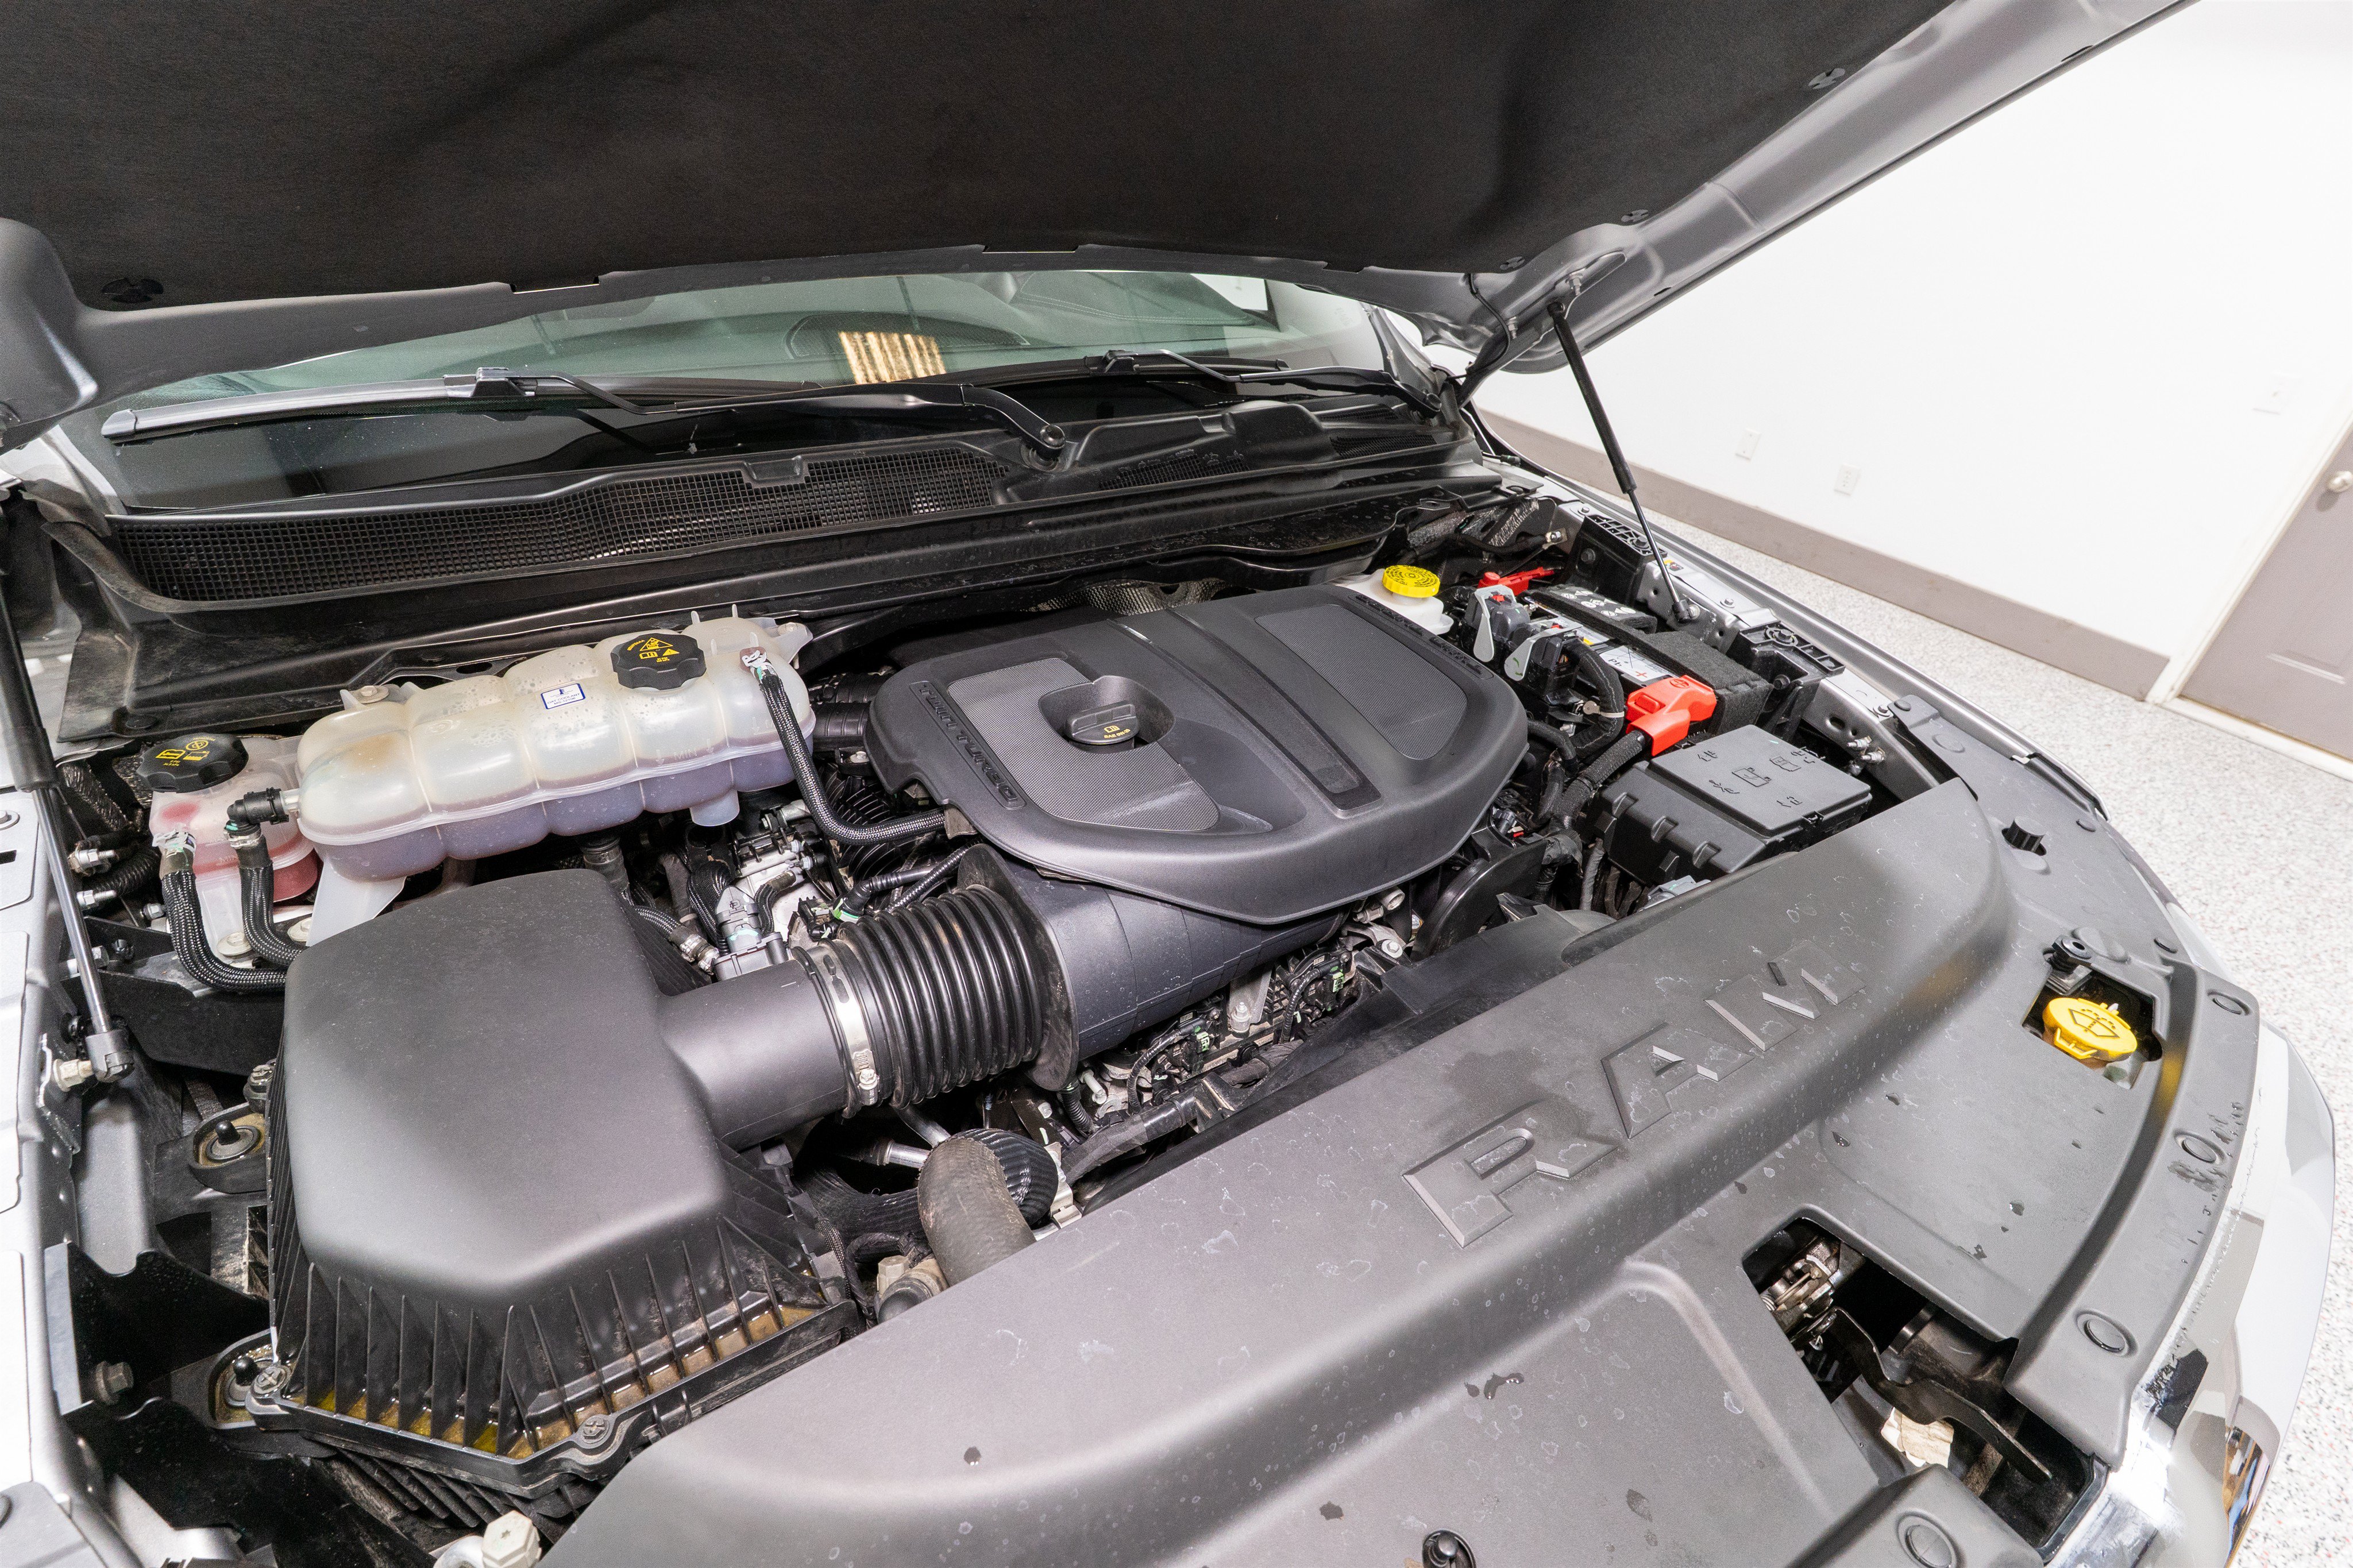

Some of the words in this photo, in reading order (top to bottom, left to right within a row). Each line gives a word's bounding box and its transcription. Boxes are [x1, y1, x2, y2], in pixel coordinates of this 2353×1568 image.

[673, 748, 698, 760] MIN
[956, 730, 1018, 804] TURBO
[1401, 939, 1867, 1248] RAM
